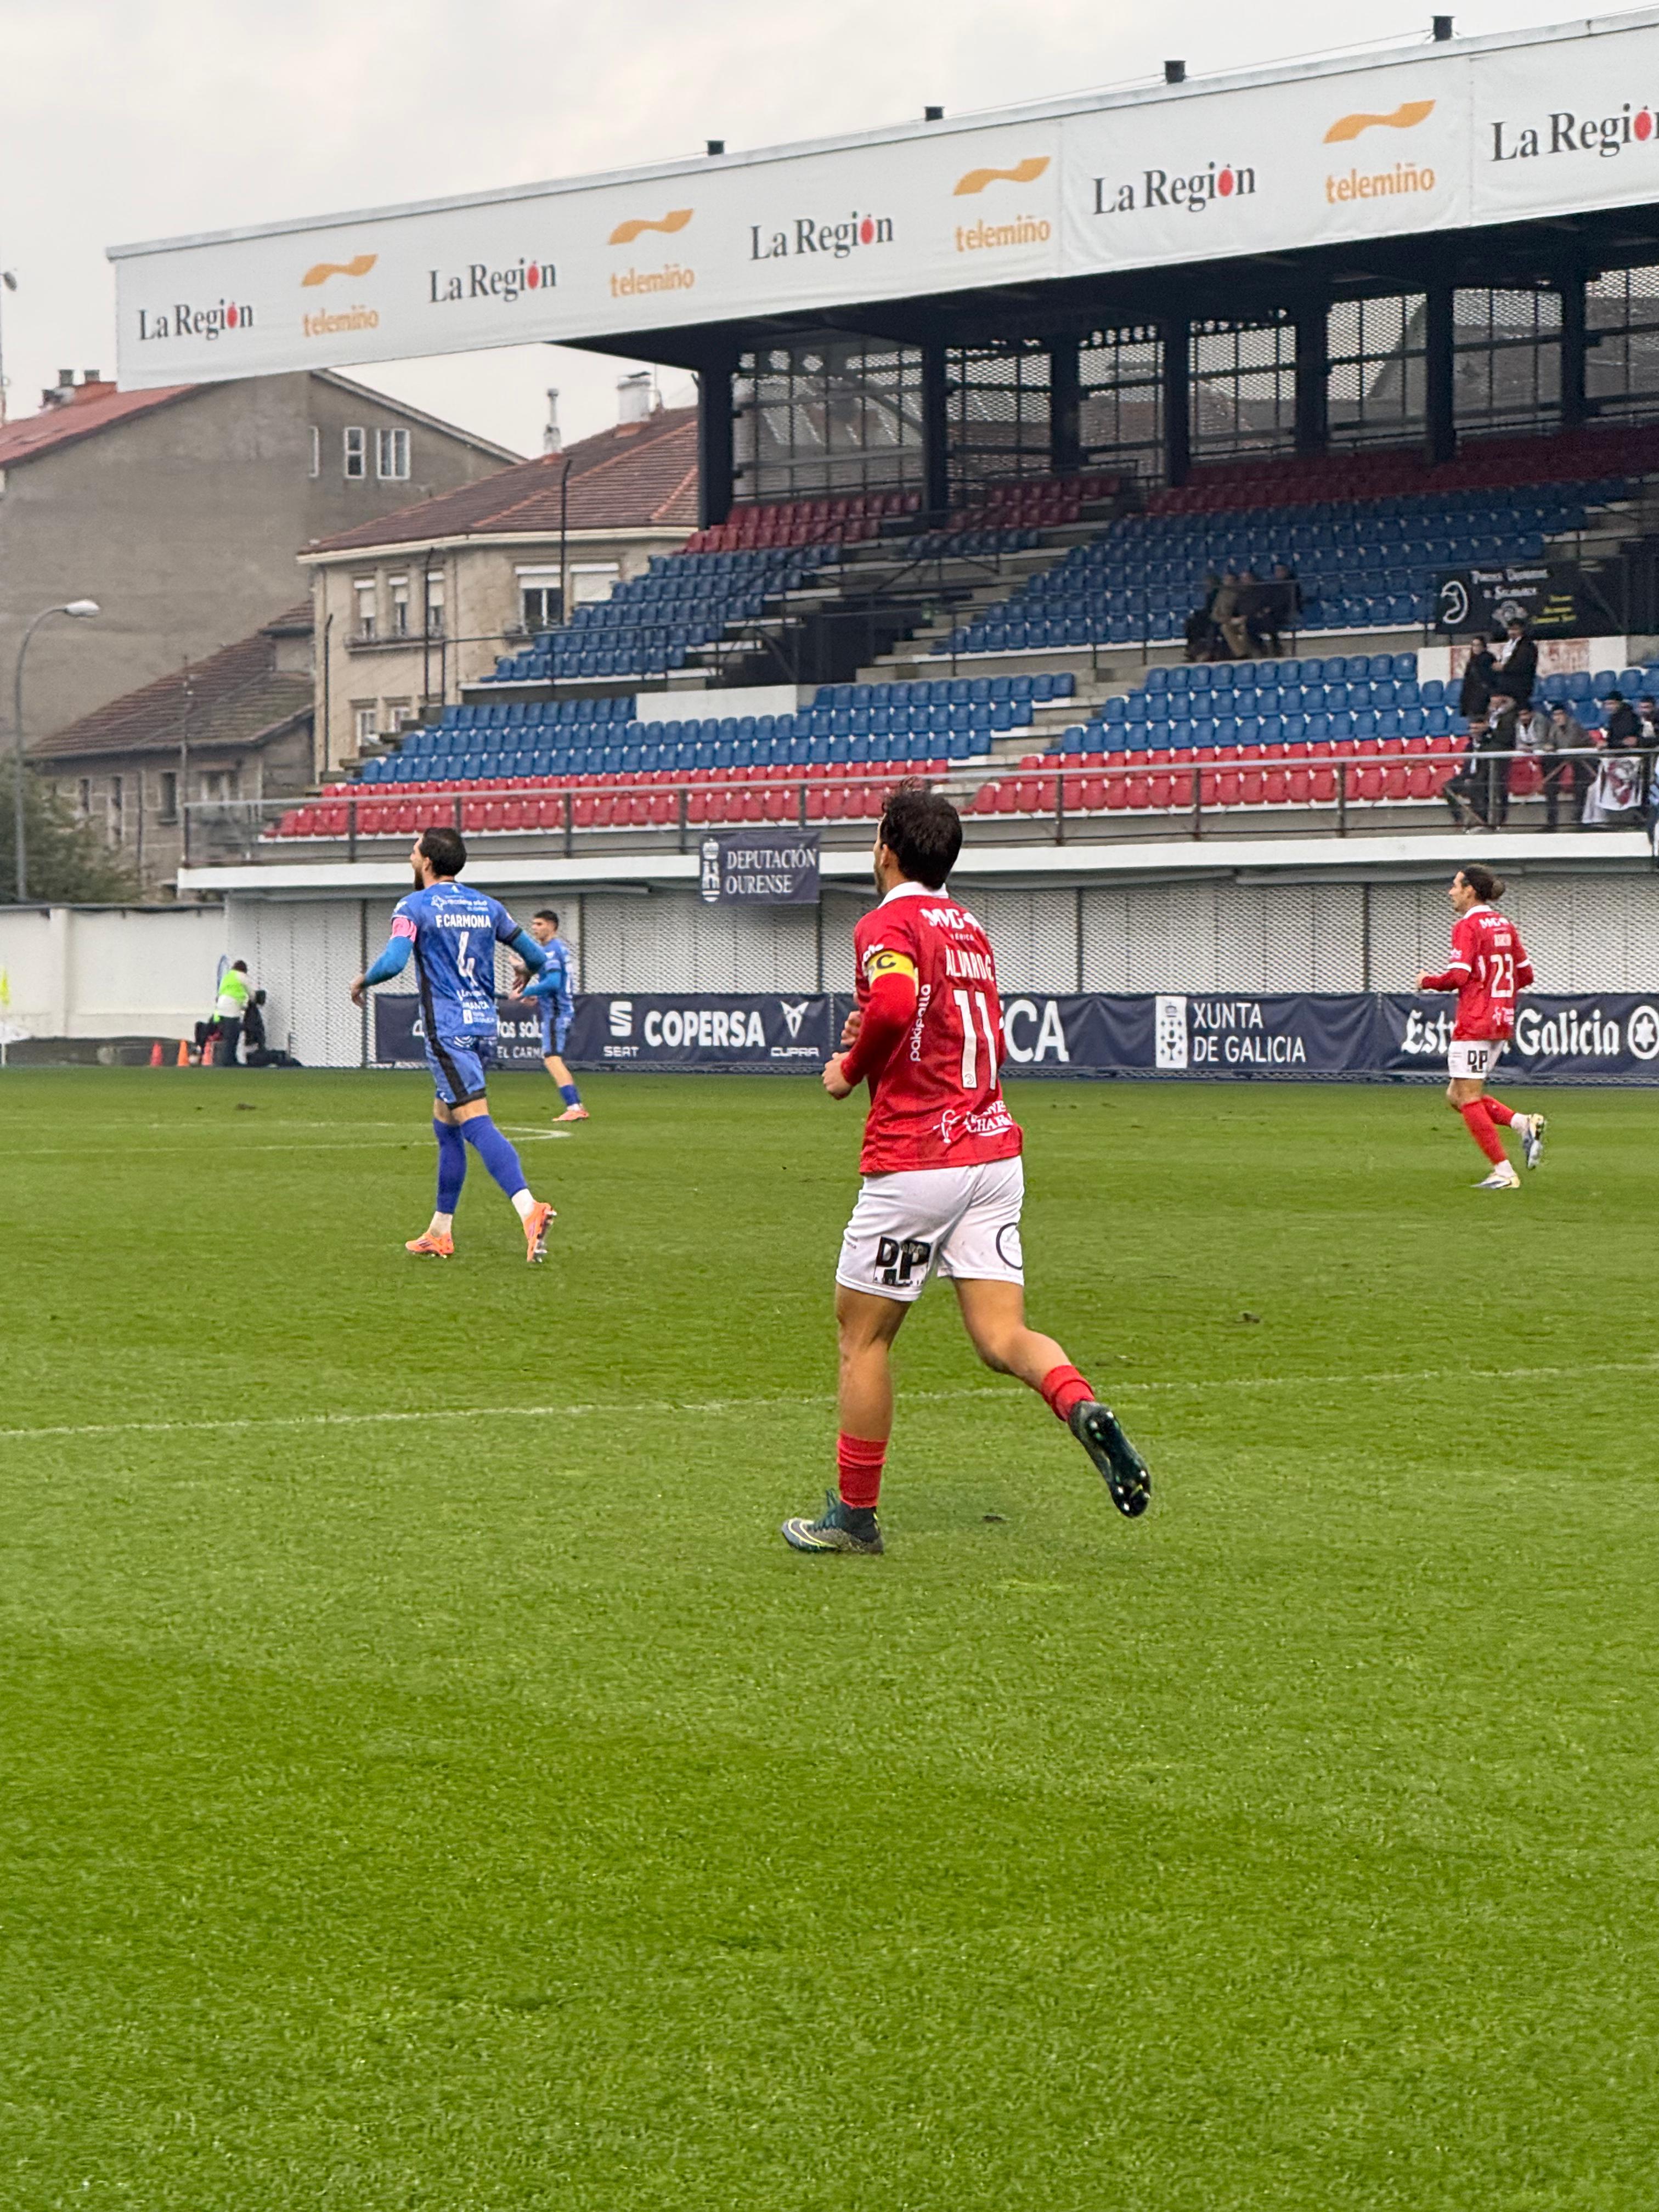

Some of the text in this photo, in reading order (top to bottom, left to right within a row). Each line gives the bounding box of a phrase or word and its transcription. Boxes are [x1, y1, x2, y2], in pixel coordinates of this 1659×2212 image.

[1491, 102, 1659, 162] La Regió
[1093, 177, 1135, 216] La
[1325, 161, 1436, 205] telemiño
[749, 225, 788, 261] La
[953, 214, 1052, 252] telemiño
[429, 269, 463, 304] La
[610, 263, 696, 298] telemiño
[138, 308, 169, 341] La
[301, 304, 380, 338] telemiño
[726, 843, 817, 869] DEPUTACIÓN
[726, 874, 793, 895] OURENSE
[457, 931, 478, 988] 4
[877, 953, 896, 969] C
[1490, 953, 1514, 998] 23
[644, 1010, 766, 1047] COPERSA
[1193, 1002, 1263, 1030] XUNTA
[1516, 1008, 1620, 1057] Galicia
[603, 1046, 640, 1058] SEAT
[770, 1047, 820, 1058] CUPRA
[953, 989, 997, 1091] 11
[1193, 1035, 1306, 1064] DE GALICIA
